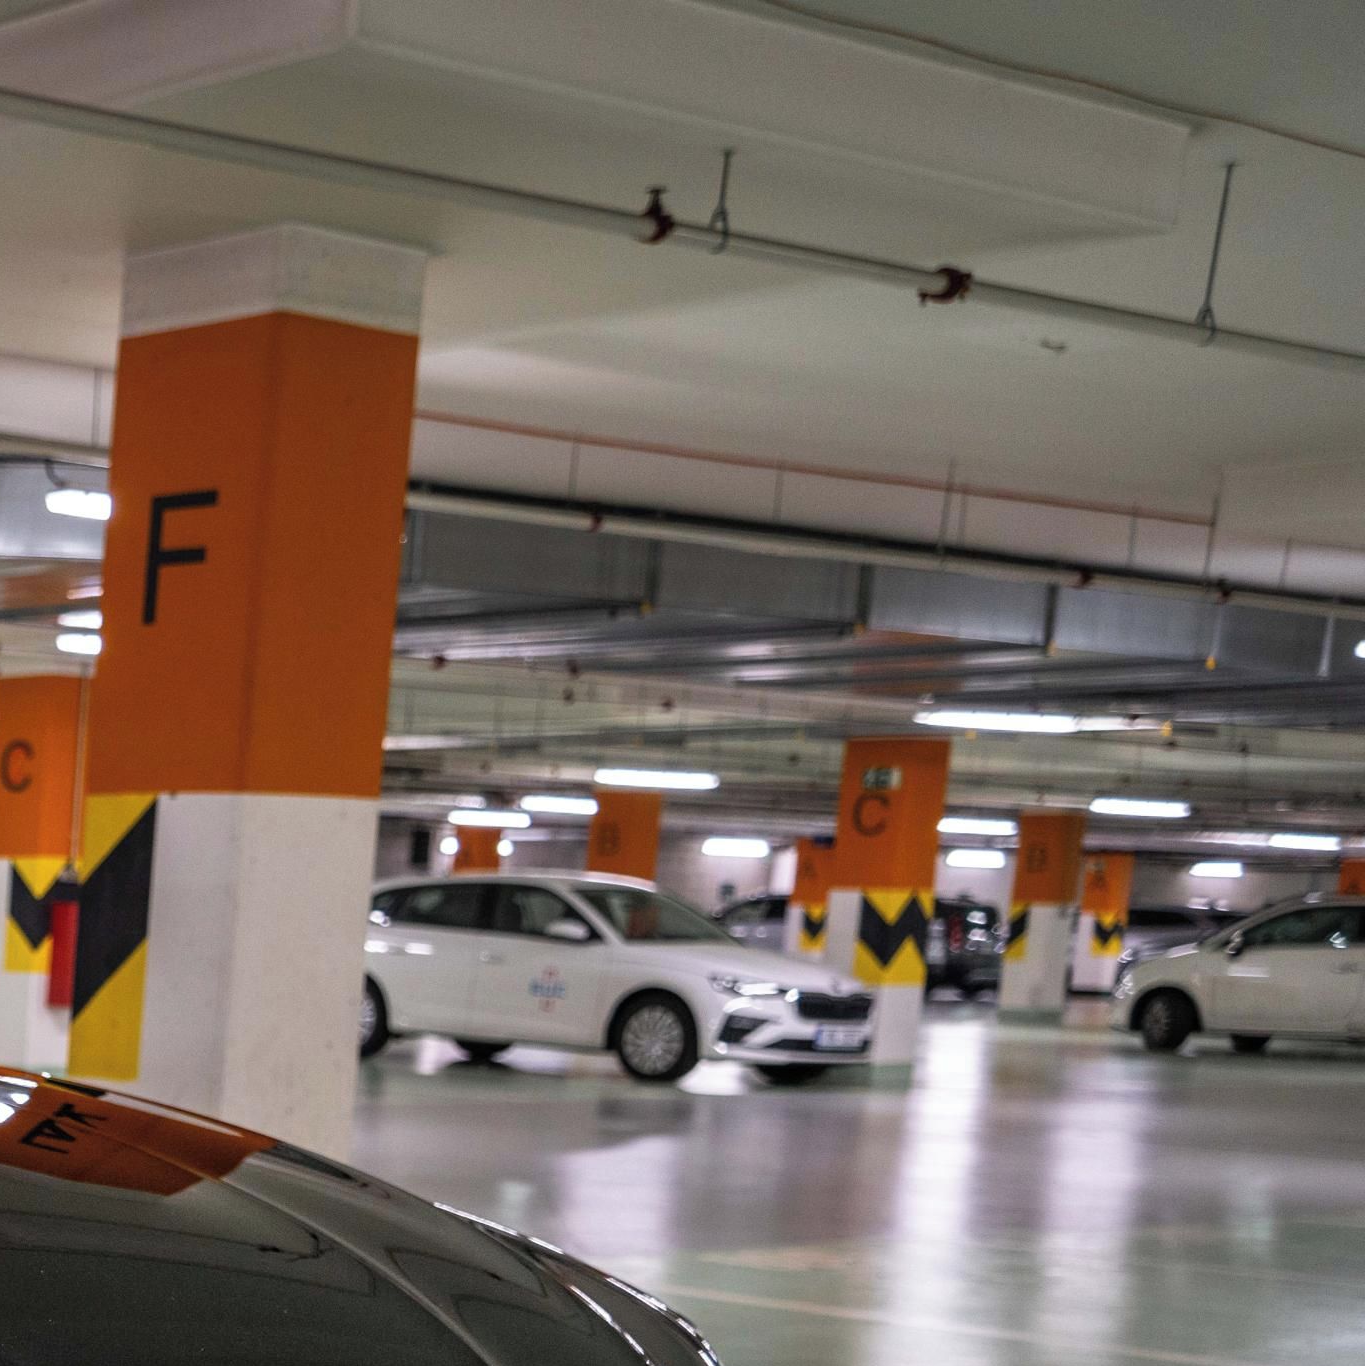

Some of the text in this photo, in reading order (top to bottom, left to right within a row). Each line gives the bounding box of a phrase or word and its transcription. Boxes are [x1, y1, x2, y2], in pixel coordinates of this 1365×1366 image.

[142, 490, 218, 624] F
[1, 741, 35, 793] C
[853, 794, 889, 836] C
